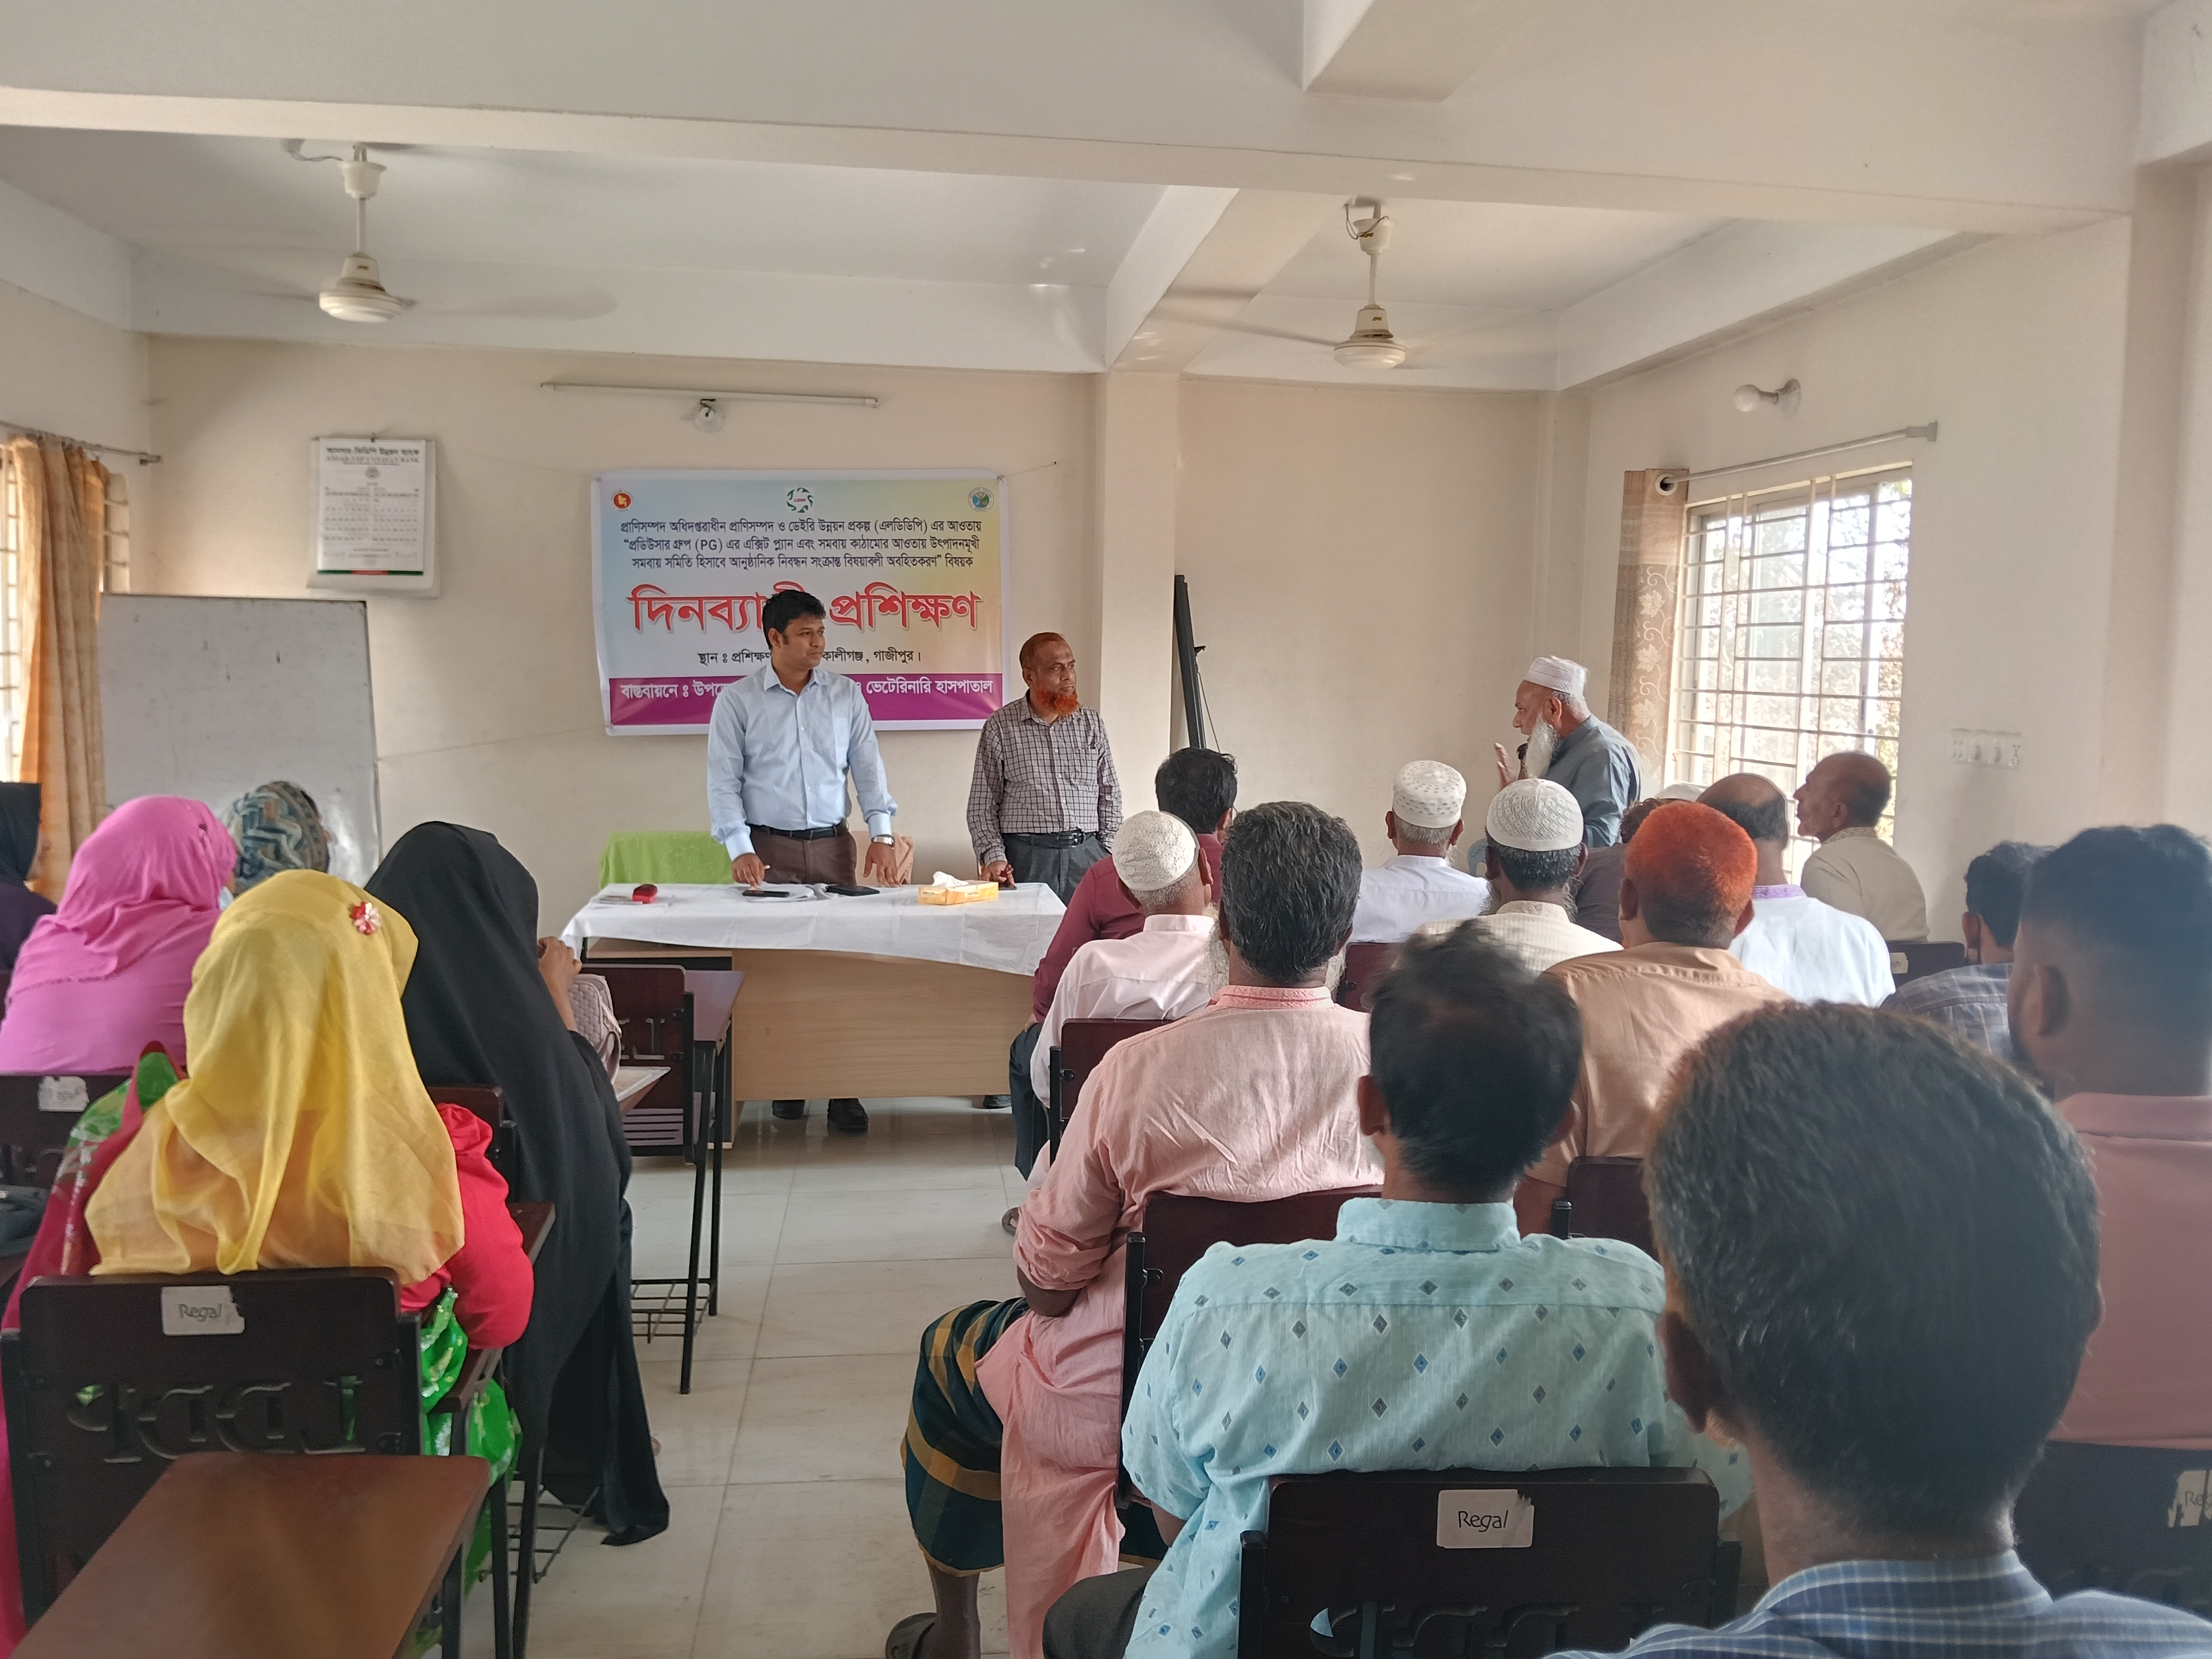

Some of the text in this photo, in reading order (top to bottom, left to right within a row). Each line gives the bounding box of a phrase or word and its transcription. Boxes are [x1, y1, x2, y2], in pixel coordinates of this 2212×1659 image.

[621, 517, 982, 534] প্রাণিসম্পদ অধিদপ্তরাধীন প্রাণিসম্পদ ও ডেইরি উন্নয়ন প্রকল্প (এলডিডিপি) এর আওতায়
[695, 538, 723, 554] (PG)
[726, 539, 740, 550] এর
[797, 539, 815, 550] এবং
[817, 538, 847, 550] সমবায়
[850, 535, 889, 550] কাঠামোর
[891, 538, 927, 550] আওতায়
[632, 558, 662, 569] সমবায়
[664, 554, 693, 568] সমিতি
[696, 554, 726, 568] হিসাবে
[777, 554, 808, 568] নিবন্ধন
[810, 556, 841, 568] সংক্রান্ত
[843, 552, 884, 568] বিষয়াবলী
[944, 553, 974, 568] বিষয়ক
[628, 581, 982, 631] দিনব্যা প্রশিক্ষণ
[697, 652, 718, 666] স্থান
[621, 683, 679, 699] বাস্তবায়নে
[866, 676, 933, 694] ভেটেরিনারি
[934, 679, 993, 694] হাসপাতাল
[178, 1303, 222, 1323] Regal
[1458, 1510, 1508, 1532] Regal
